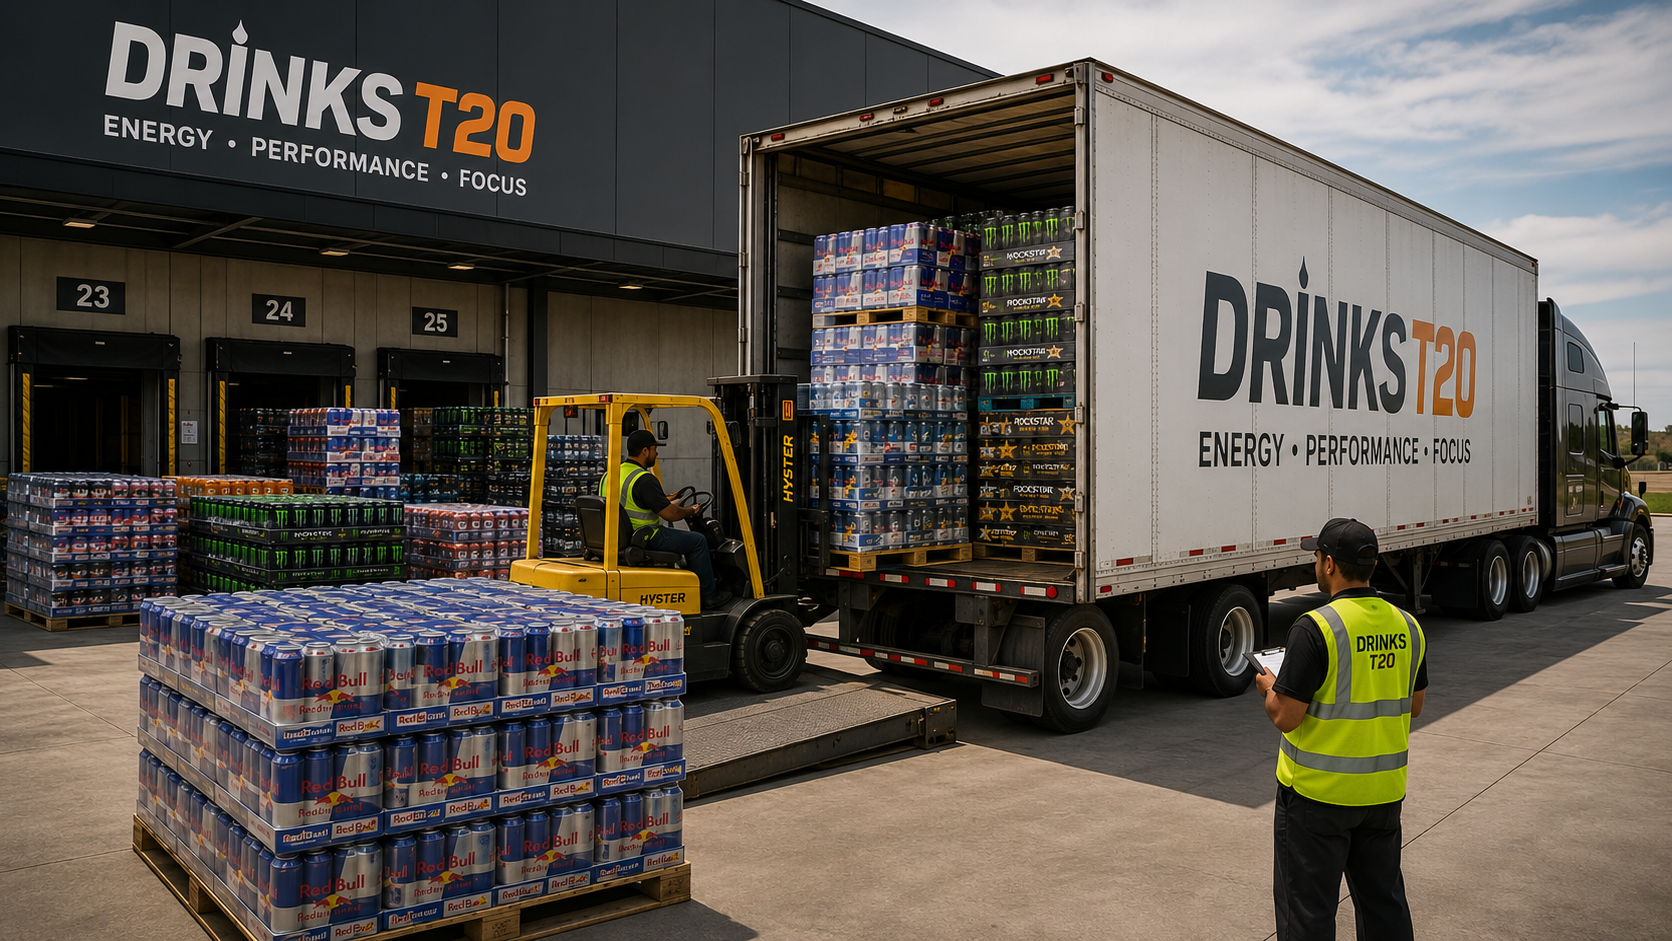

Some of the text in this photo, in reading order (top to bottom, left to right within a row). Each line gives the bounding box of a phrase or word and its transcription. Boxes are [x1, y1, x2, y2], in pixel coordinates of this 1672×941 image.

[105, 20, 536, 164] DRINKS T20
[104, 114, 527, 197] ENERGY PERFORMANCE FOCUS
[76, 283, 110, 308] 23
[265, 299, 294, 322] 24
[423, 312, 448, 332] 25
[1197, 256, 1476, 418] DRINKS T20
[1198, 431, 1471, 467] ENERGY PERFORMANCE FOCUS
[782, 434, 794, 503] HYSTER
[640, 592, 686, 606] HYSTER
[648, 638, 671, 653] Bull
[1356, 633, 1407, 653] DRINKS
[554, 647, 581, 663] Bull
[1369, 652, 1396, 670] T20
[455, 659, 483, 675] Bull
[337, 671, 367, 688] Bull
[647, 724, 670, 740] Bull
[554, 739, 580, 756] Bull
[452, 754, 480, 771] Bull
[301, 772, 367, 794] Red Bull
[646, 812, 669, 827] Bull
[553, 831, 579, 848] Bull
[448, 851, 476, 869] Bull
[300, 873, 365, 898] Red Bull
